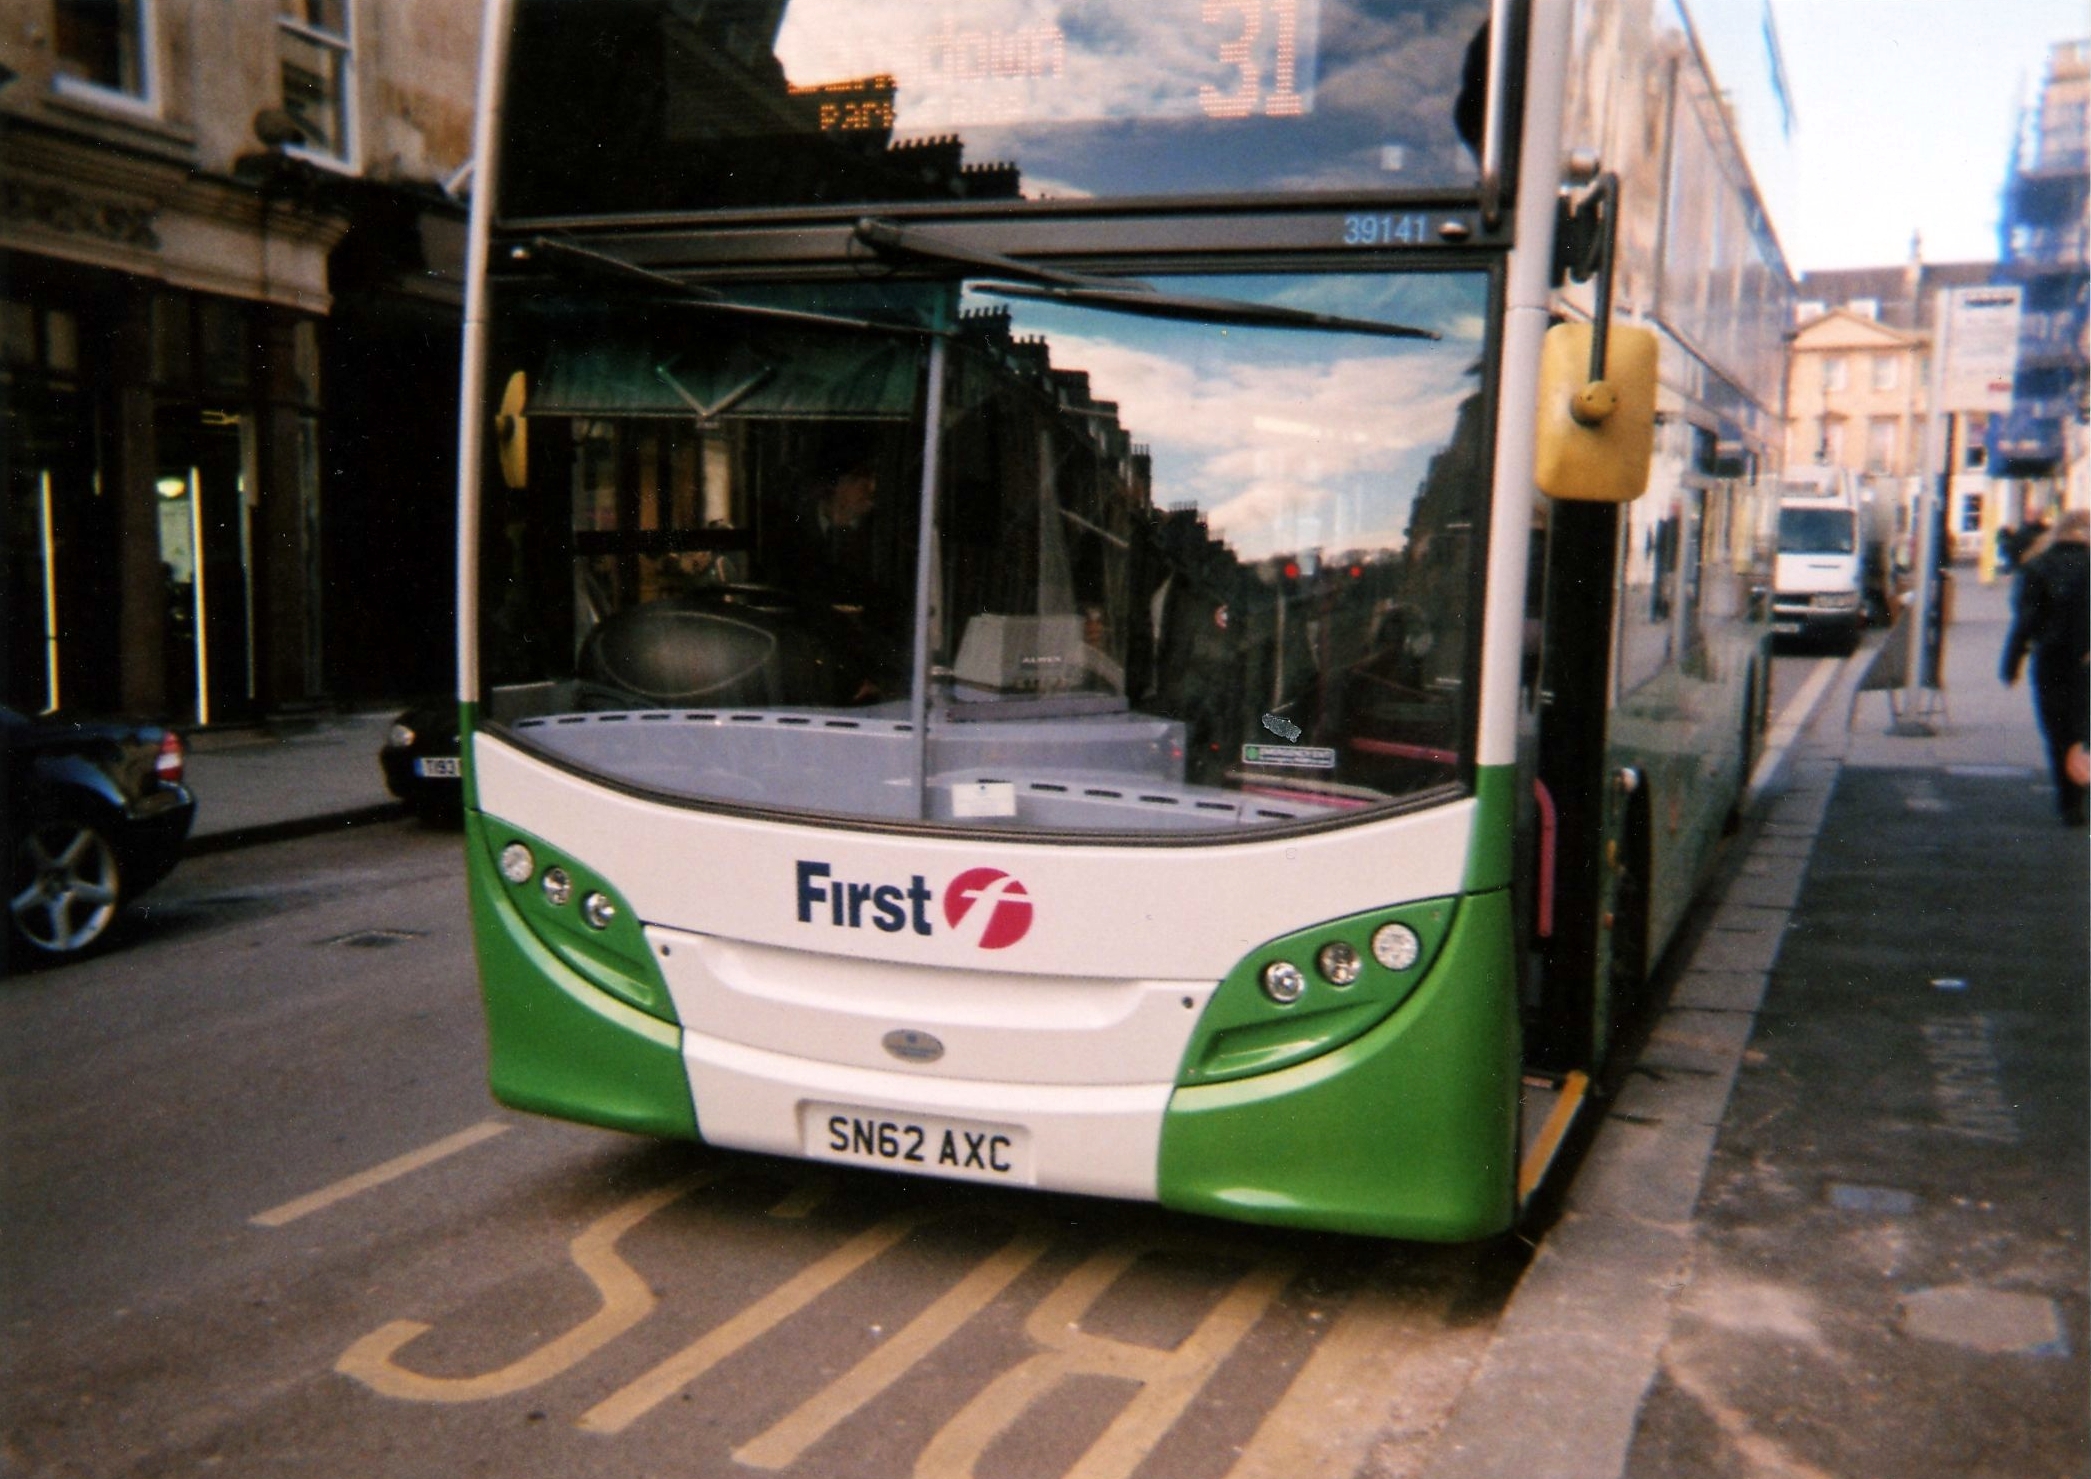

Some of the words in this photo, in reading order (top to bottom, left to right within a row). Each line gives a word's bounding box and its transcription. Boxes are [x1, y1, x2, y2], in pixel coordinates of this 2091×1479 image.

[1199, 0, 1303, 118] 31
[1344, 214, 1428, 245] 39141
[796, 860, 932, 936] First
[828, 1116, 924, 1162] SN62
[939, 1129, 1012, 1172] AXC
